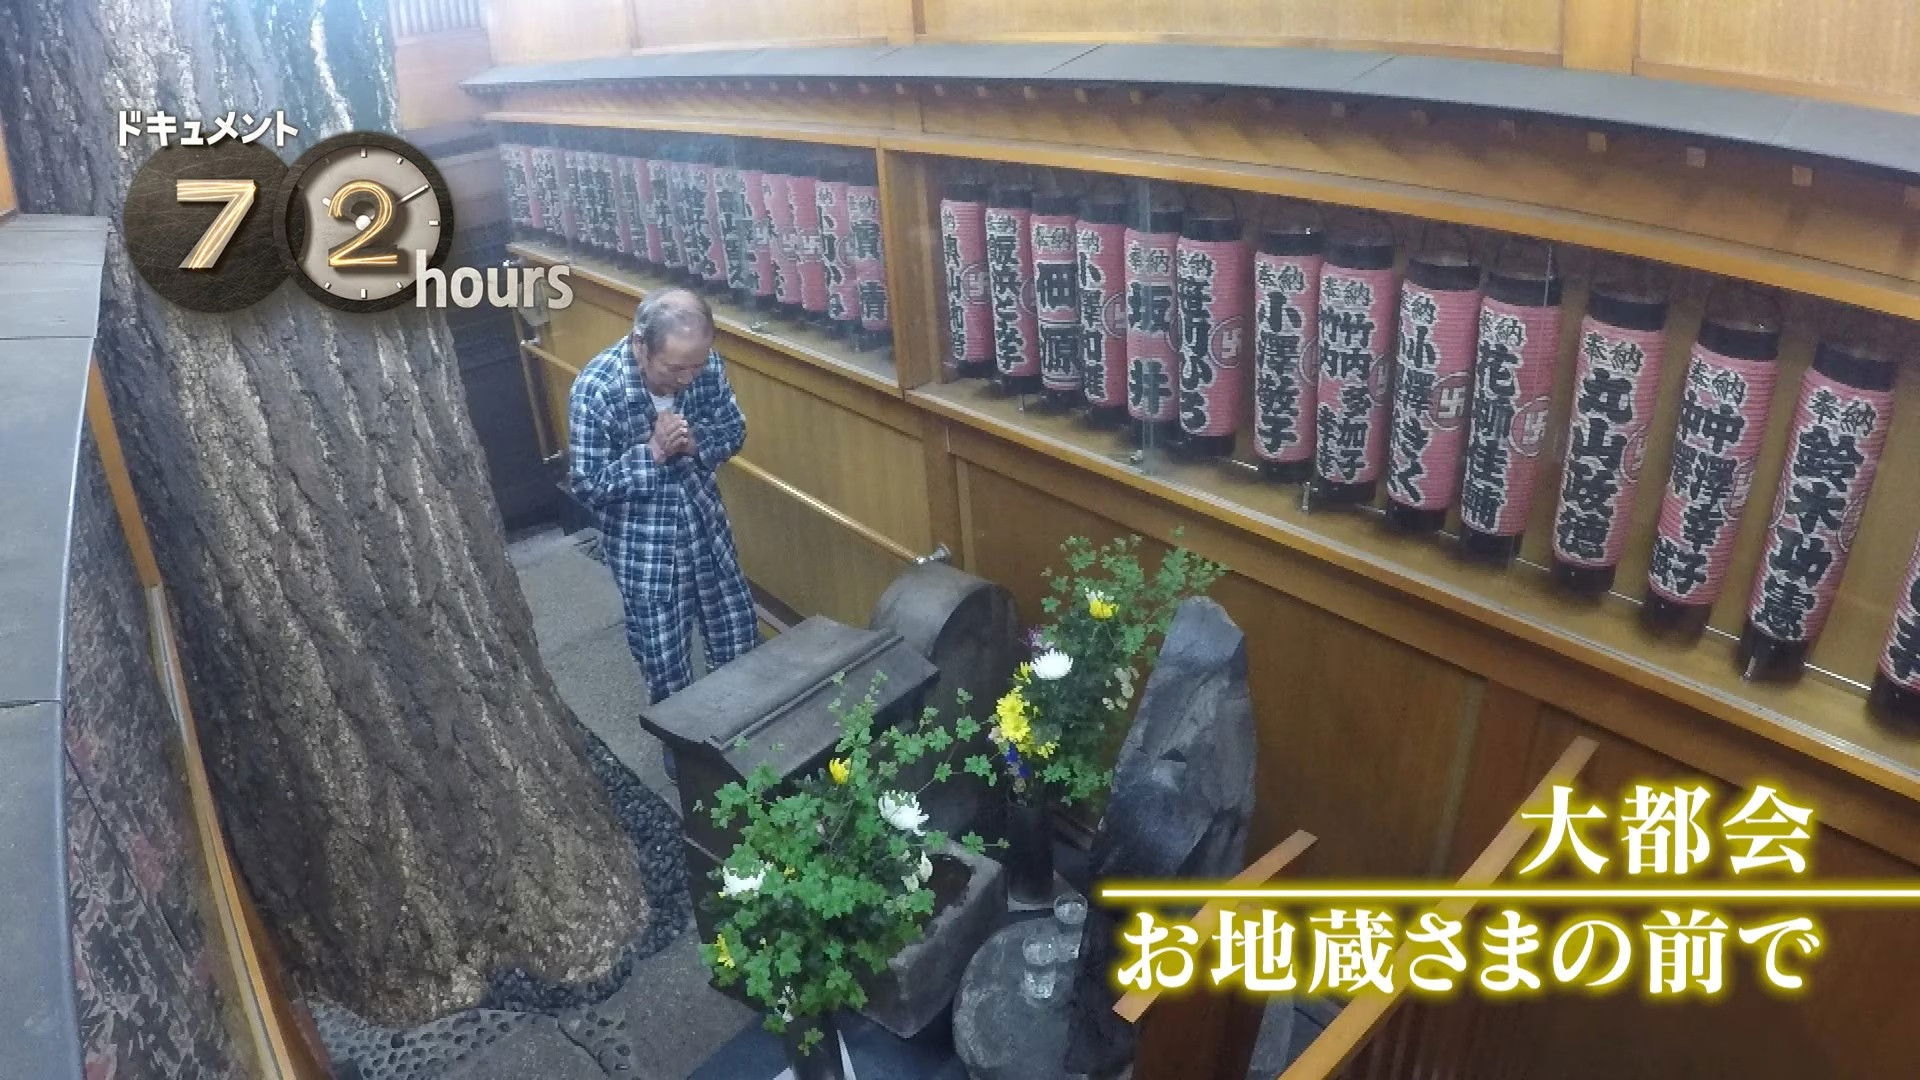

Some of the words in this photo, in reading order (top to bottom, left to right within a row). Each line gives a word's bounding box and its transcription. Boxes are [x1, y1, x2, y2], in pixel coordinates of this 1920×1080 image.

[1258, 263, 1306, 292] 奉納
[1323, 277, 1374, 304] 奉納
[1480, 305, 1526, 348] 奉納
[1585, 331, 1645, 373] 奉納
[1691, 357, 1747, 404] 奉納
[1808, 387, 1877, 436] 奉納
